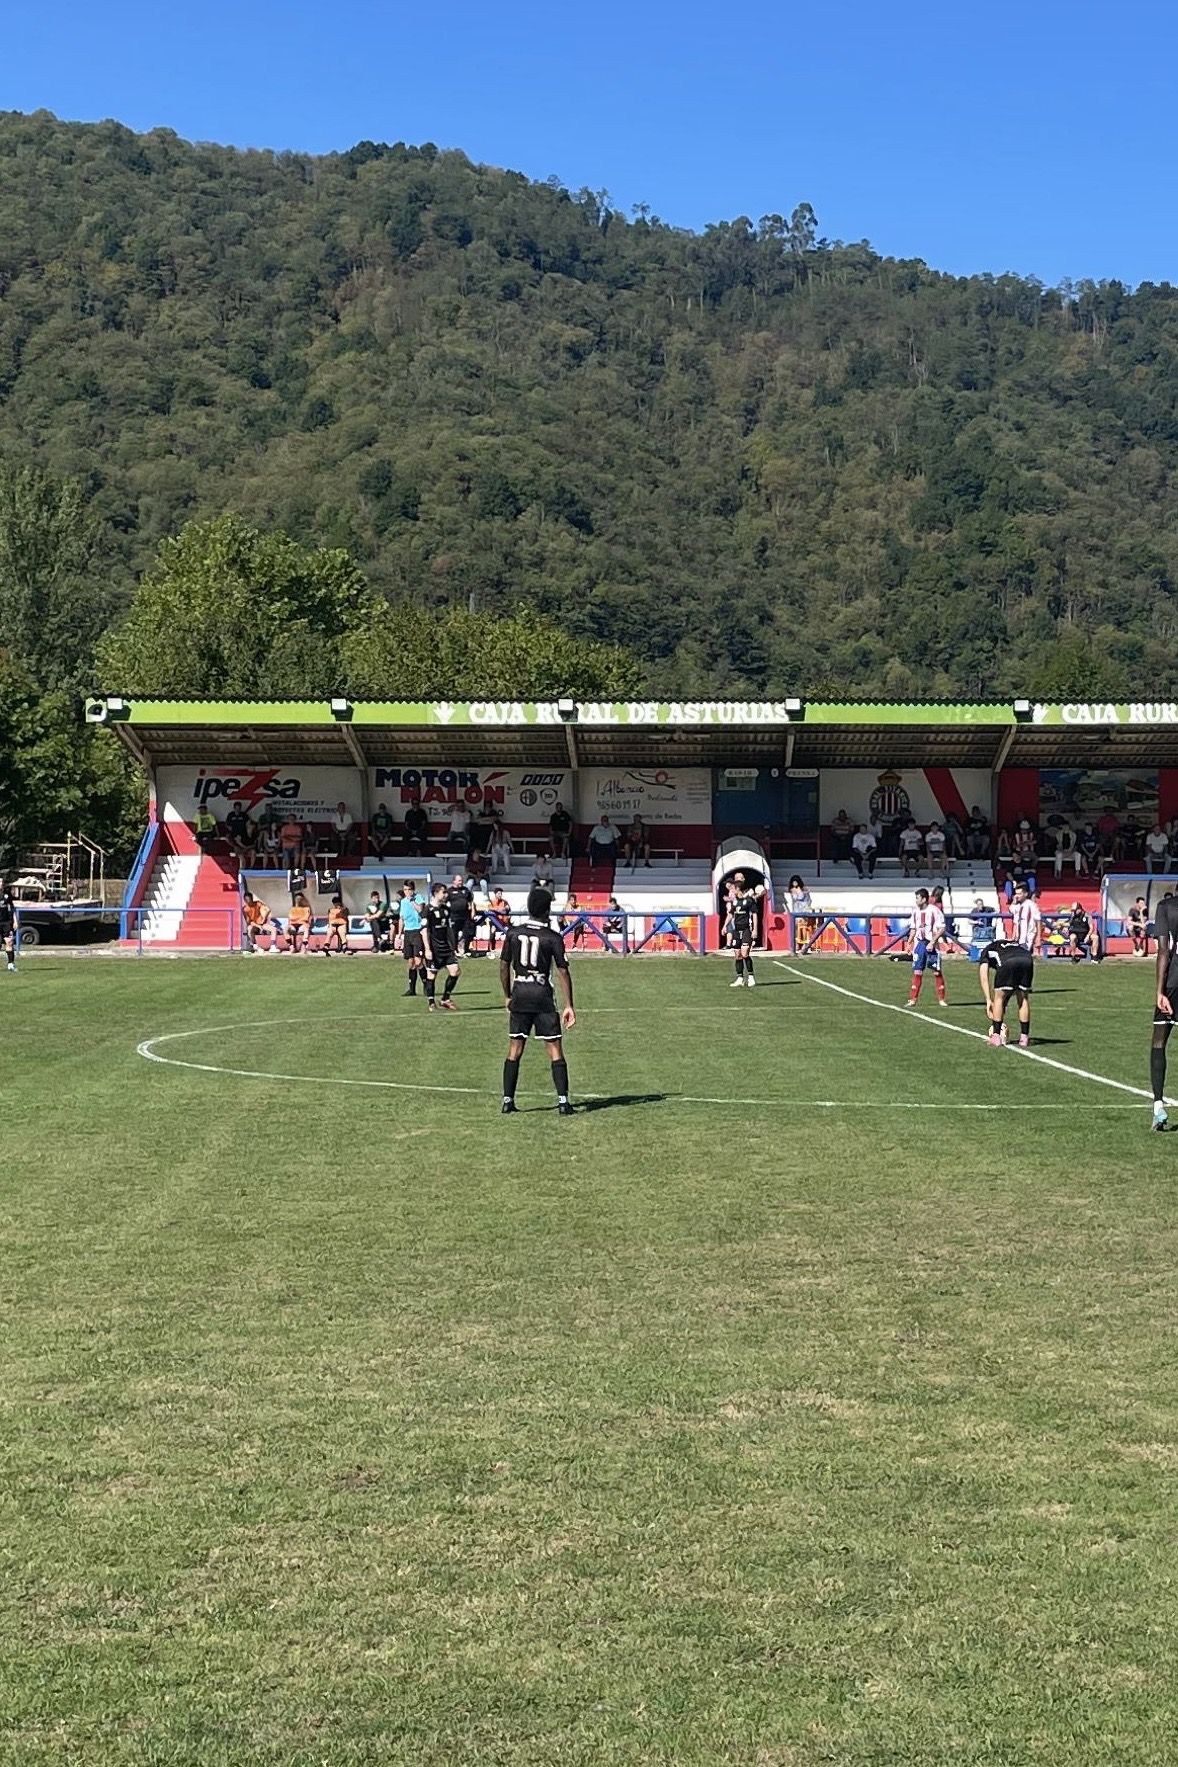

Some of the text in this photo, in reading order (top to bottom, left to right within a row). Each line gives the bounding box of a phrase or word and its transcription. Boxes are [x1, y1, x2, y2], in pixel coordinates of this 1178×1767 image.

[469, 702, 527, 724] CAJA
[627, 702, 659, 723] DE
[666, 702, 790, 723] ASTURIAS
[376, 769, 480, 787] MOTOR
[518, 935, 540, 967] 11
